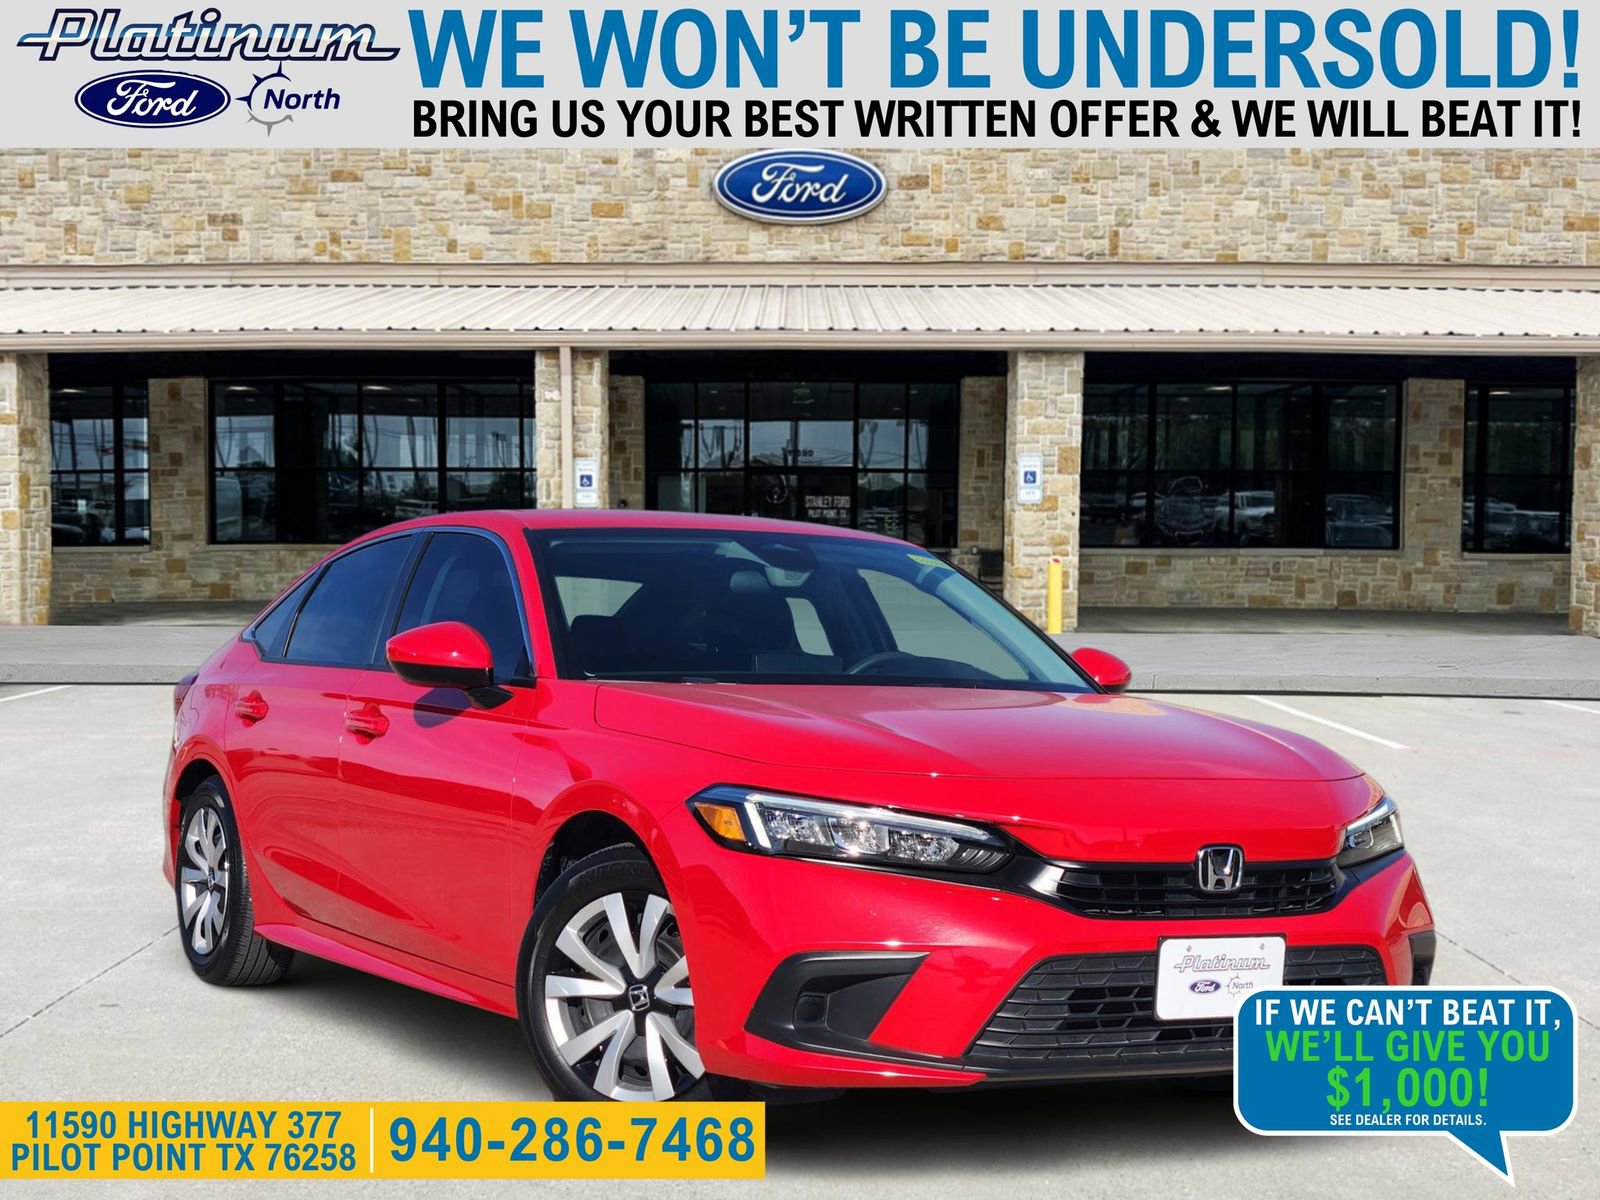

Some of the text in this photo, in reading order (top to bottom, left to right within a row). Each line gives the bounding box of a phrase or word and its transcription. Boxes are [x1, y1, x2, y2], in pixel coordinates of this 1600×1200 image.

[752, 163, 848, 203] Ford
[1174, 954, 1270, 973] Platinum
[1194, 981, 1216, 992] Ford
[1232, 981, 1253, 990] North
